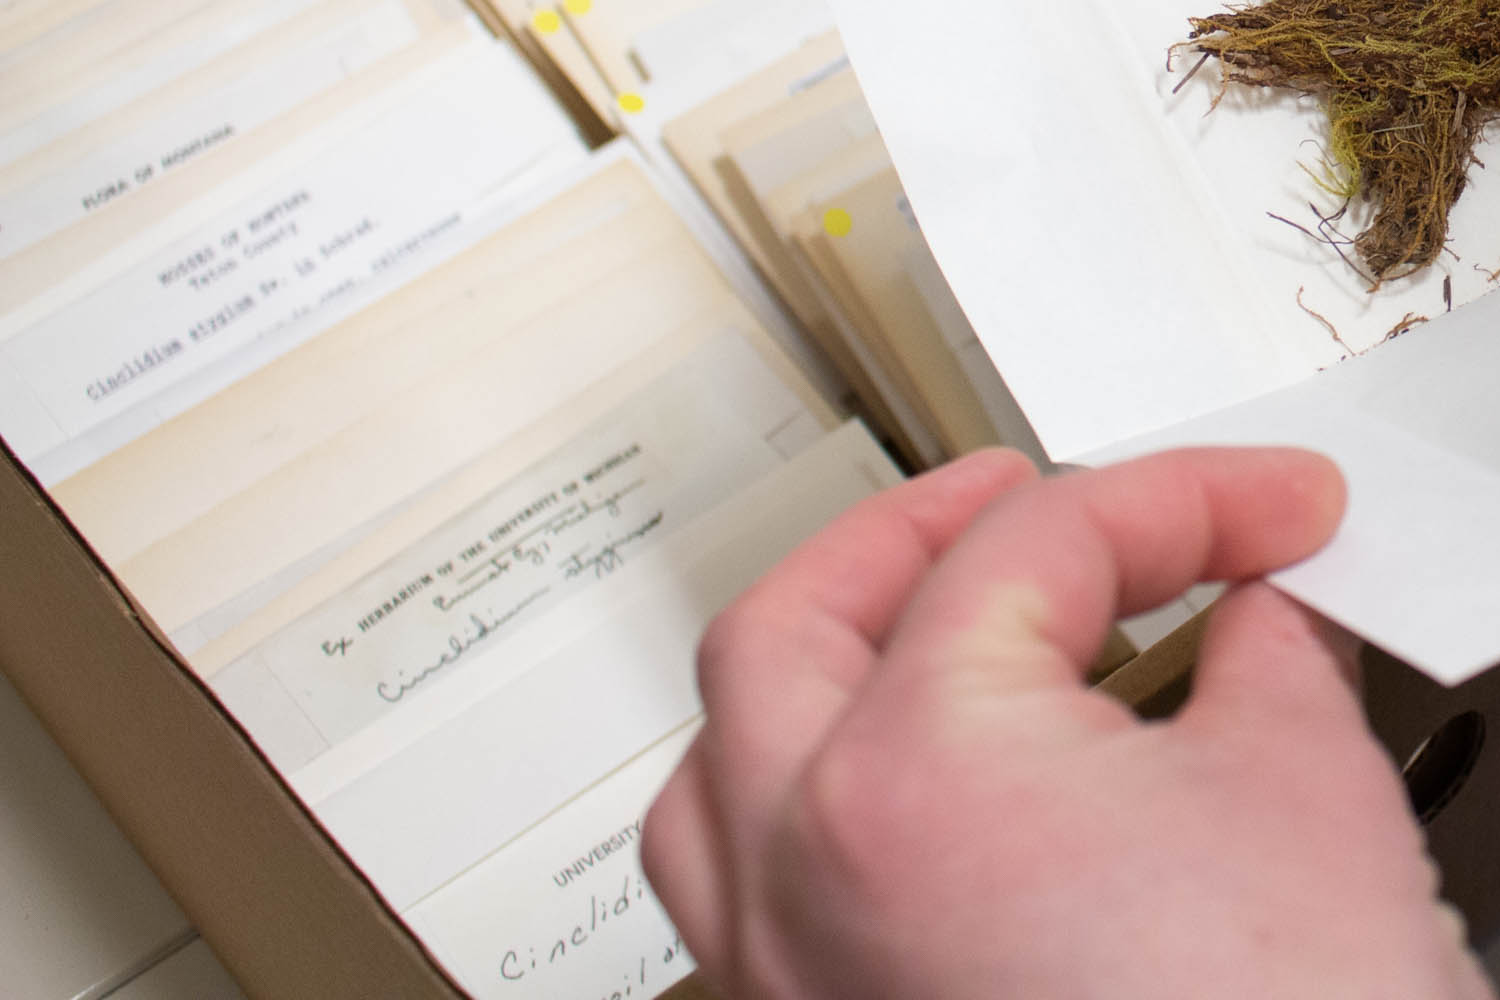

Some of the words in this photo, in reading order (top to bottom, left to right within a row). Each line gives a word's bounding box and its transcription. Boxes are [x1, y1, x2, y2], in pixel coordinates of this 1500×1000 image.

[82, 179, 129, 211] FLORA
[133, 162, 155, 184] OF
[160, 122, 236, 170] MONTANA
[221, 229, 239, 248] OF
[243, 220, 298, 260] County
[86, 339, 183, 403] Cinclidium
[357, 574, 433, 632] HERBARIUM
[436, 560, 454, 577] OF
[459, 543, 487, 562] THE
[487, 491, 559, 543] UNIVERSITY
[561, 480, 579, 497] OF
[582, 443, 642, 483] MICHIGAN
[553, 818, 641, 887] UNIVERSITY
[500, 874, 643, 981] Cinclidi
